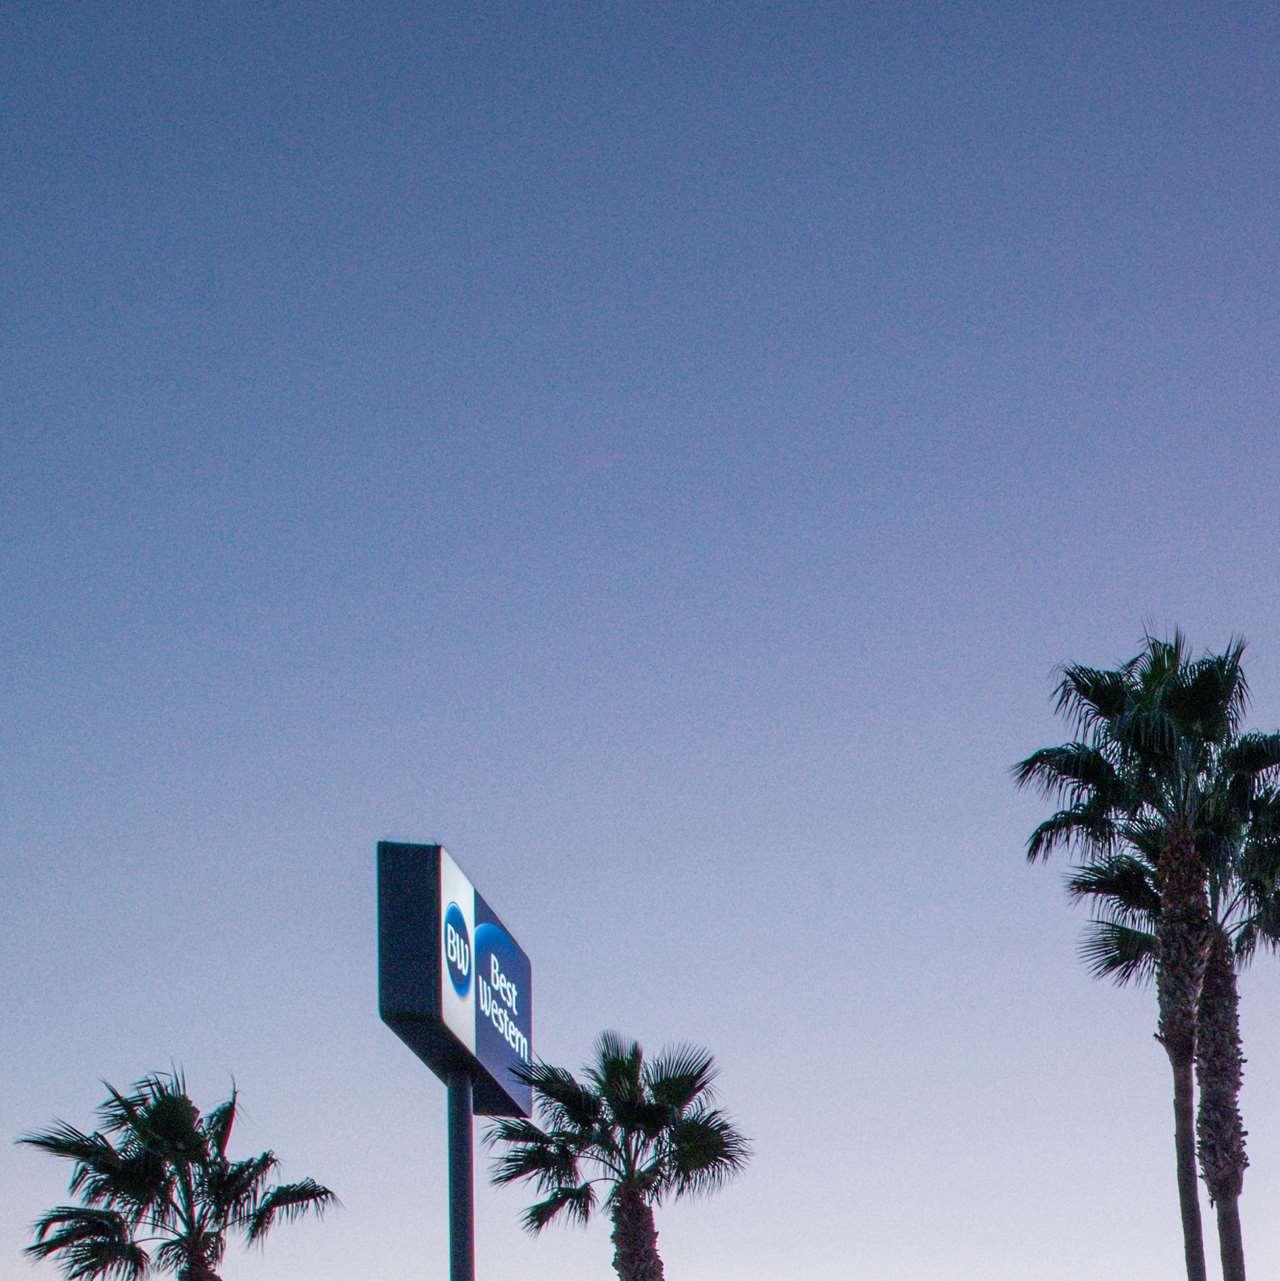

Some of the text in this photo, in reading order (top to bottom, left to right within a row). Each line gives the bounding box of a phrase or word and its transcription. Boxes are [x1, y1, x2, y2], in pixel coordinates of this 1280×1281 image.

[447, 922, 469, 977] BW
[491, 953, 518, 1016] Best
[478, 975, 529, 1065] Western
